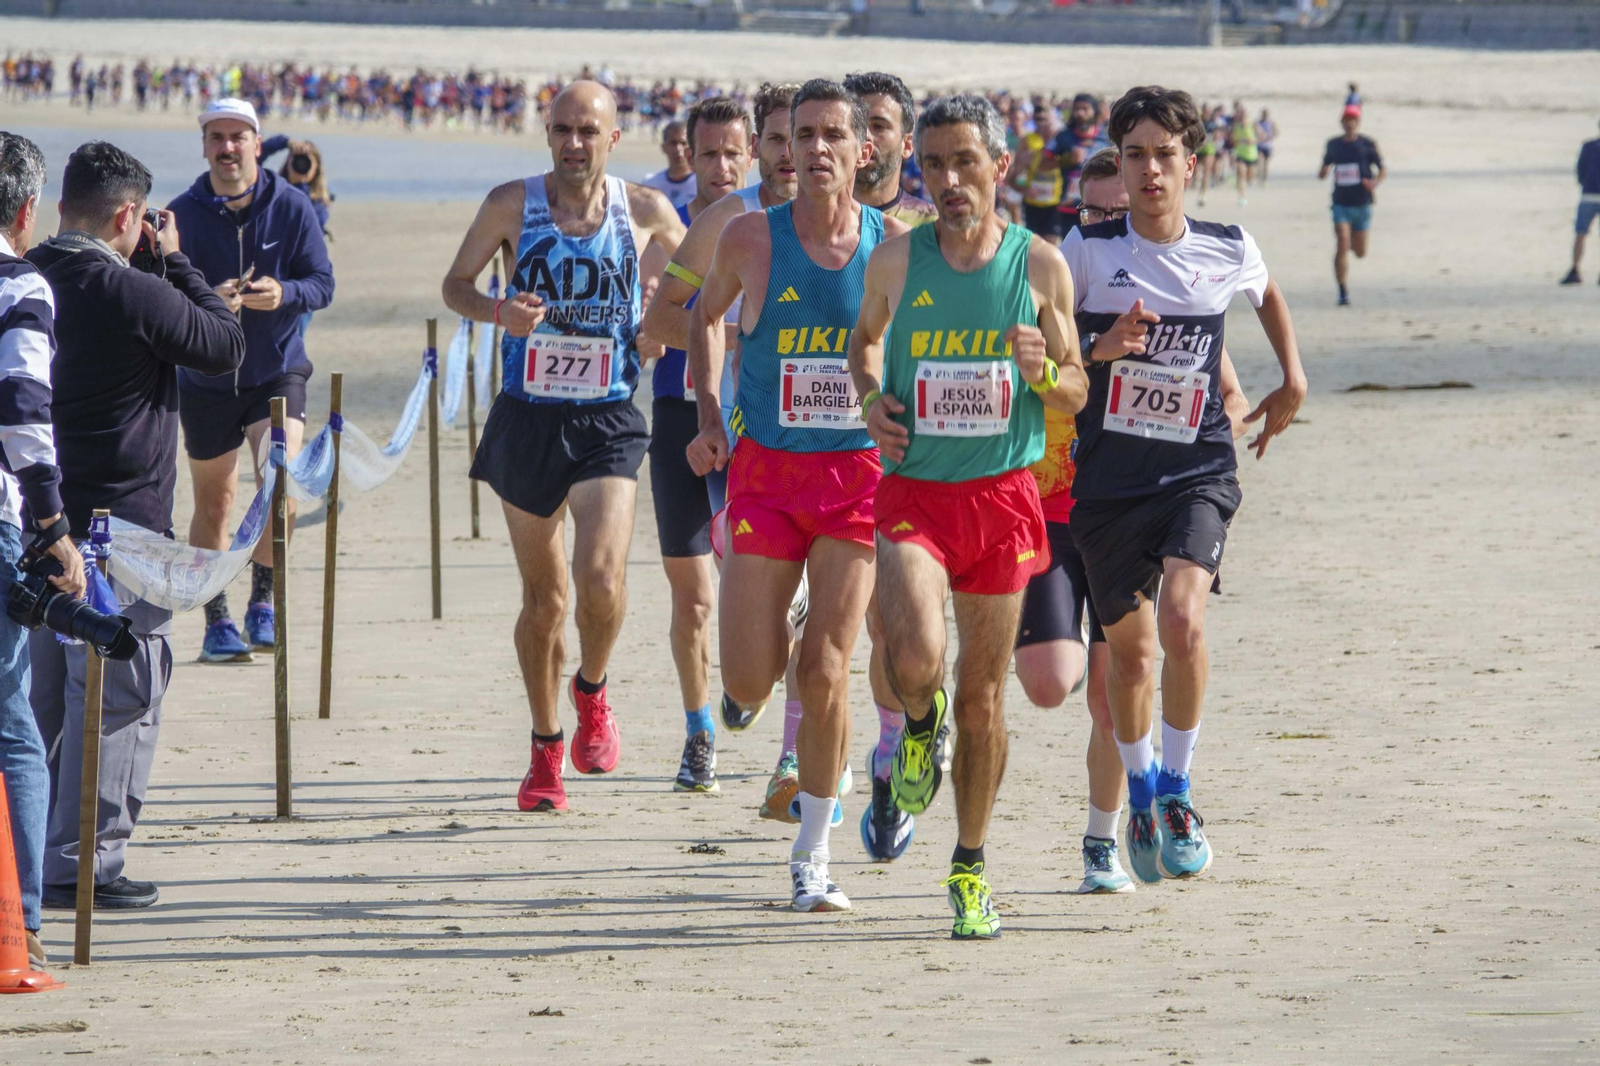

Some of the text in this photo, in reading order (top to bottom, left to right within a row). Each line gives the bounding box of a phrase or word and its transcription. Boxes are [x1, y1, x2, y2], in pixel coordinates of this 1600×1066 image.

[526, 255, 635, 302] ADN
[543, 303, 629, 325] UNNERS
[777, 326, 854, 355] BIKI
[1134, 324, 1212, 356] likia
[545, 355, 592, 377] 277
[1170, 355, 1196, 367] fresh
[811, 381, 847, 394] DANI
[940, 386, 986, 402] JESÚS
[793, 395, 862, 408] BARGIELA
[934, 401, 993, 416] ESPAÑA
[1131, 385, 1182, 414] 705
